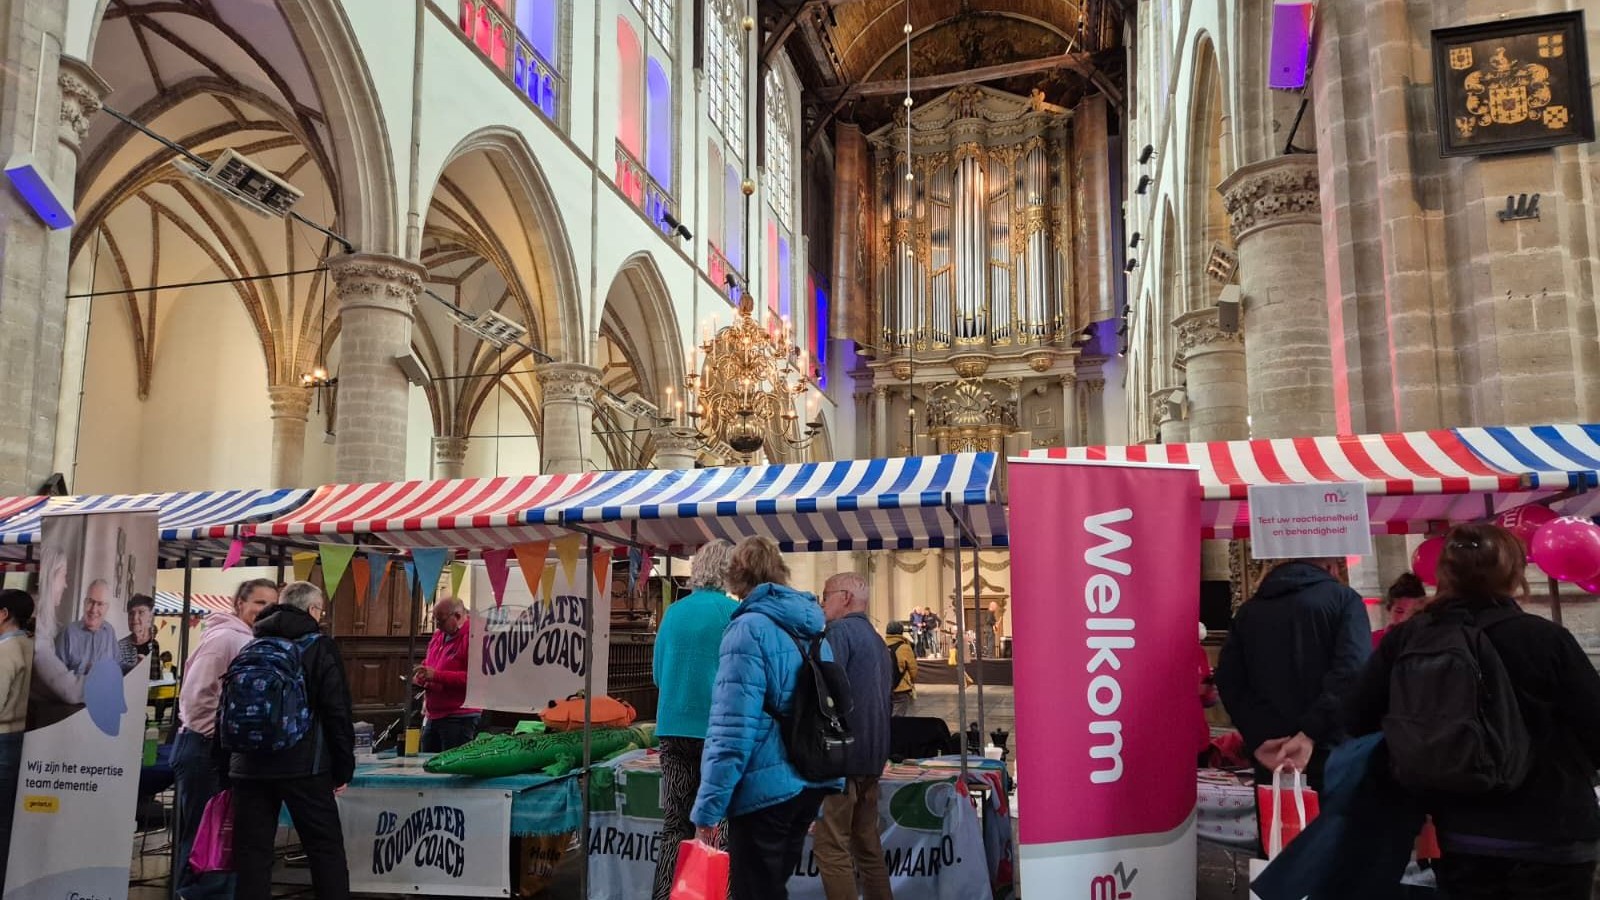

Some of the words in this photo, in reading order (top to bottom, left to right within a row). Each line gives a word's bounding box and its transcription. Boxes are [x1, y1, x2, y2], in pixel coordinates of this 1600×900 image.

[1258, 516, 1275, 524] Test
[1292, 513, 1358, 524] reactiesnelheid
[1286, 525, 1348, 537] behendigheid!
[1083, 507, 1136, 784] Welkom
[27, 761, 42, 774] Wij
[45, 761, 60, 774] zijn
[62, 762, 77, 774] het
[80, 765, 124, 777] expertise
[26, 778, 51, 789] team
[53, 779, 98, 792] dementie
[375, 810, 398, 836] DE
[372, 805, 465, 875] KOUDWATER
[414, 834, 465, 878] COACH
